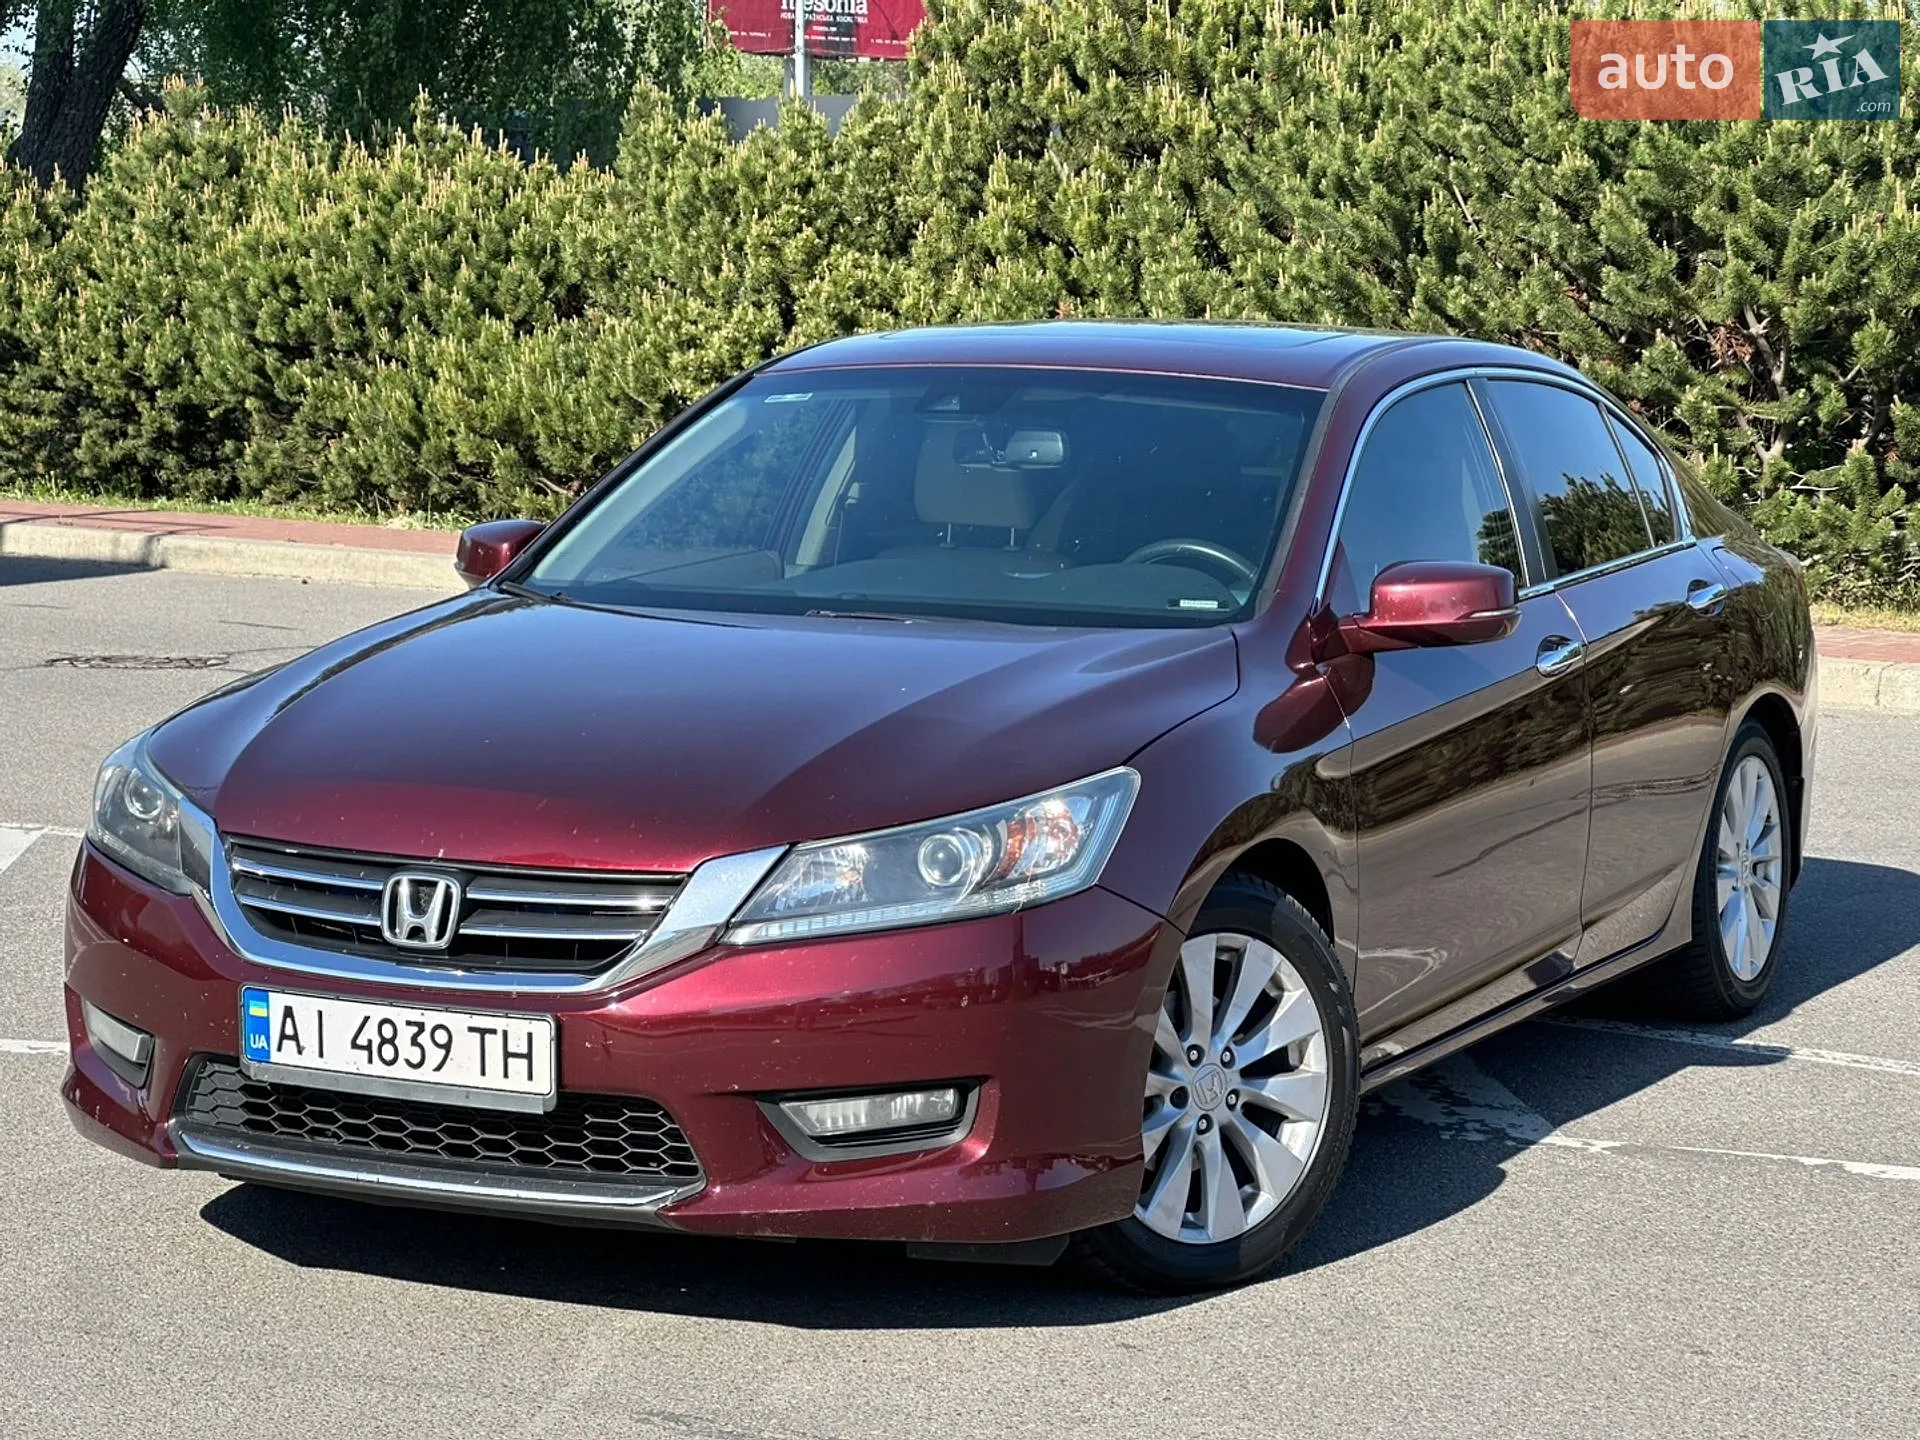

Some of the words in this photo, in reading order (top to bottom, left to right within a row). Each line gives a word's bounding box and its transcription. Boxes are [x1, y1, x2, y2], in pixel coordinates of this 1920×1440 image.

[250, 1033, 269, 1050] UA
[275, 1005, 325, 1059] AI
[350, 1015, 454, 1072] 4839
[467, 1026, 534, 1082] TH
